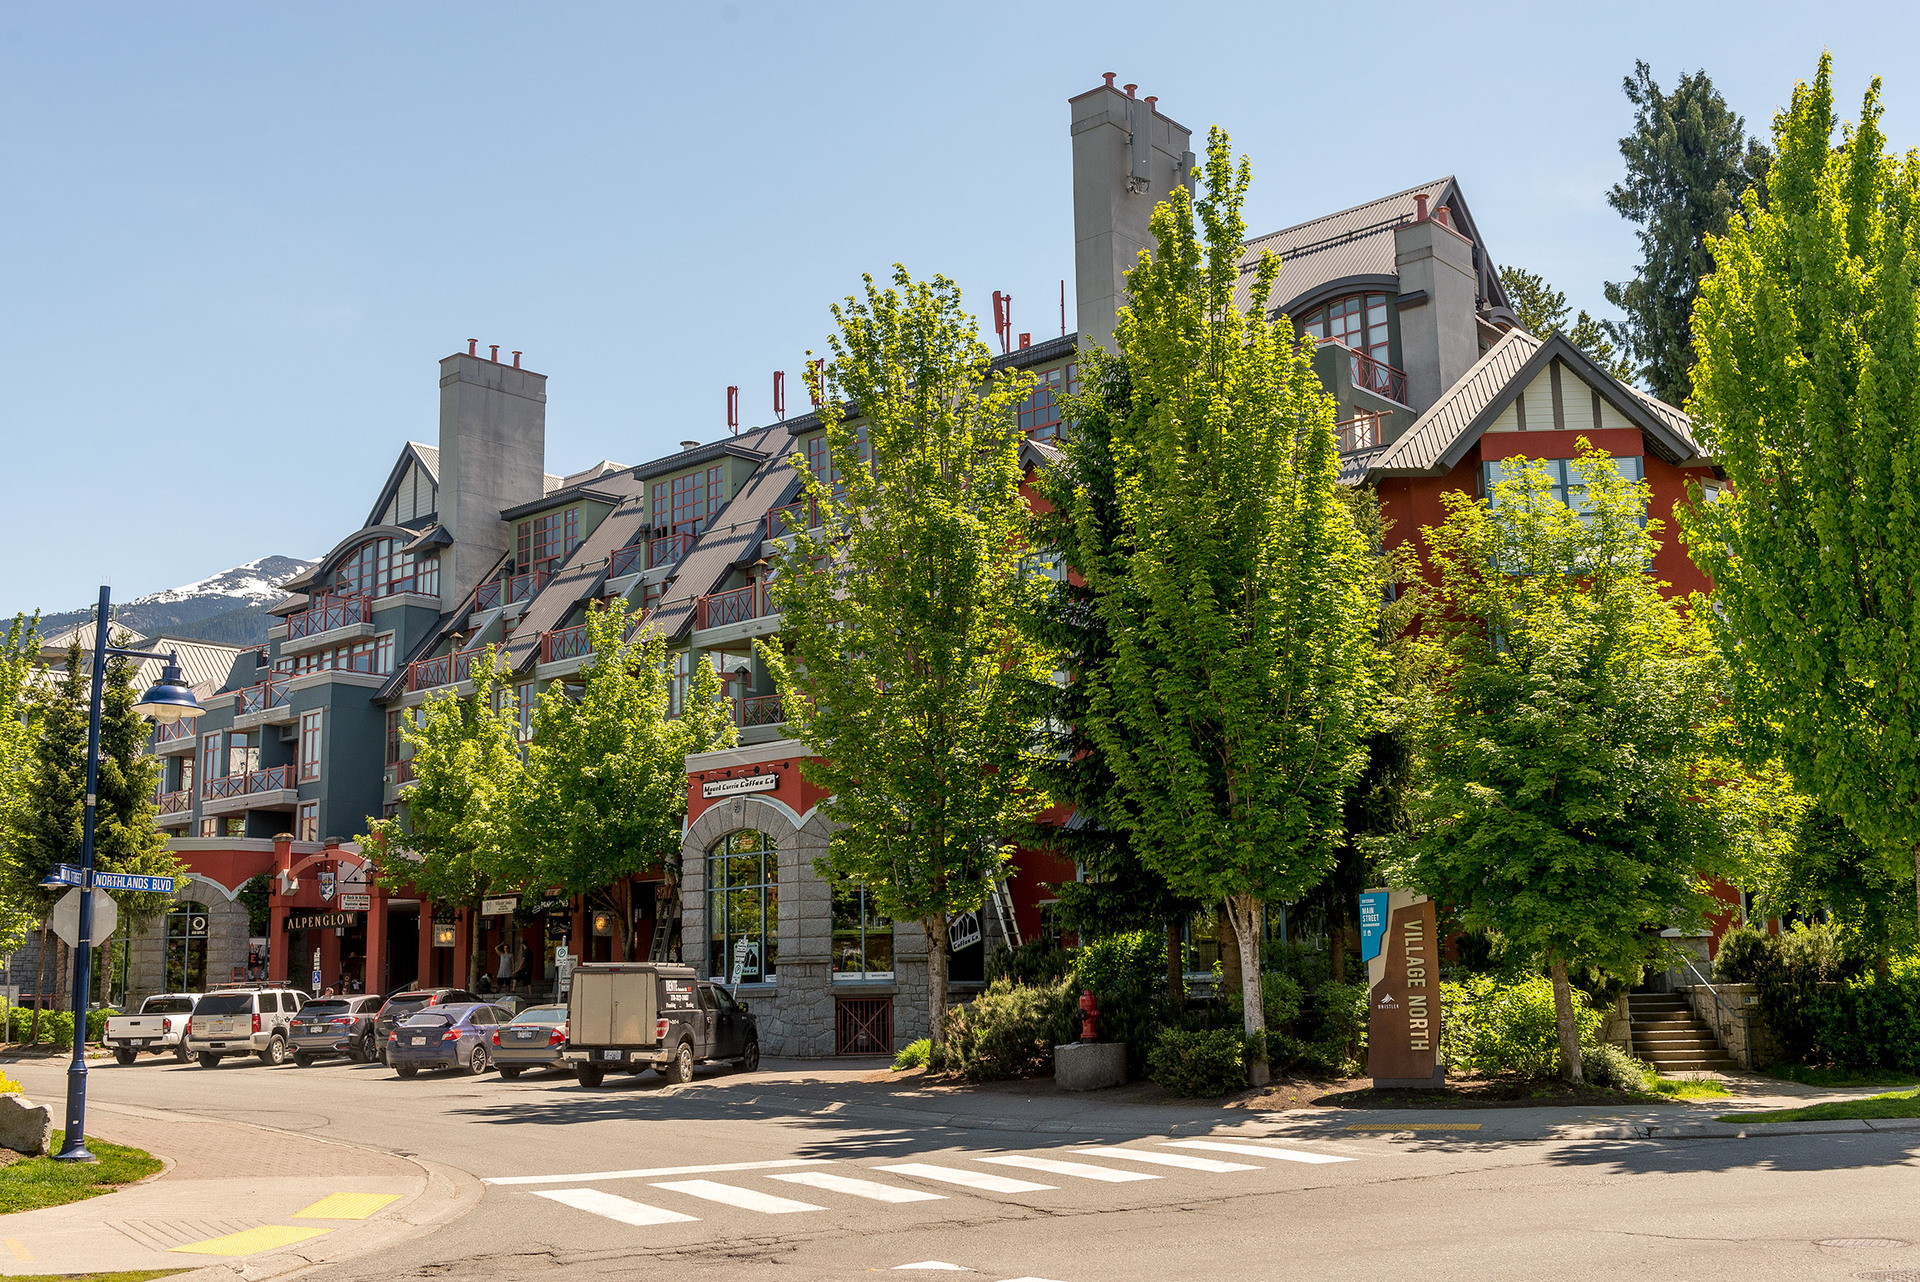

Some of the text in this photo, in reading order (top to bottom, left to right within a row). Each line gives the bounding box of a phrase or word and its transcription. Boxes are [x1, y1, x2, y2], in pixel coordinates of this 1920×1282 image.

[704, 777, 774, 795] Mount Currie Coffee Co
[95, 873, 172, 891] NORTHLANDS BLVD
[287, 913, 354, 930] ALPENGLOW
[1362, 914, 1380, 922] STREET
[953, 939, 971, 950] Coffee
[1404, 919, 1430, 1050] VILLAGE NORTH
